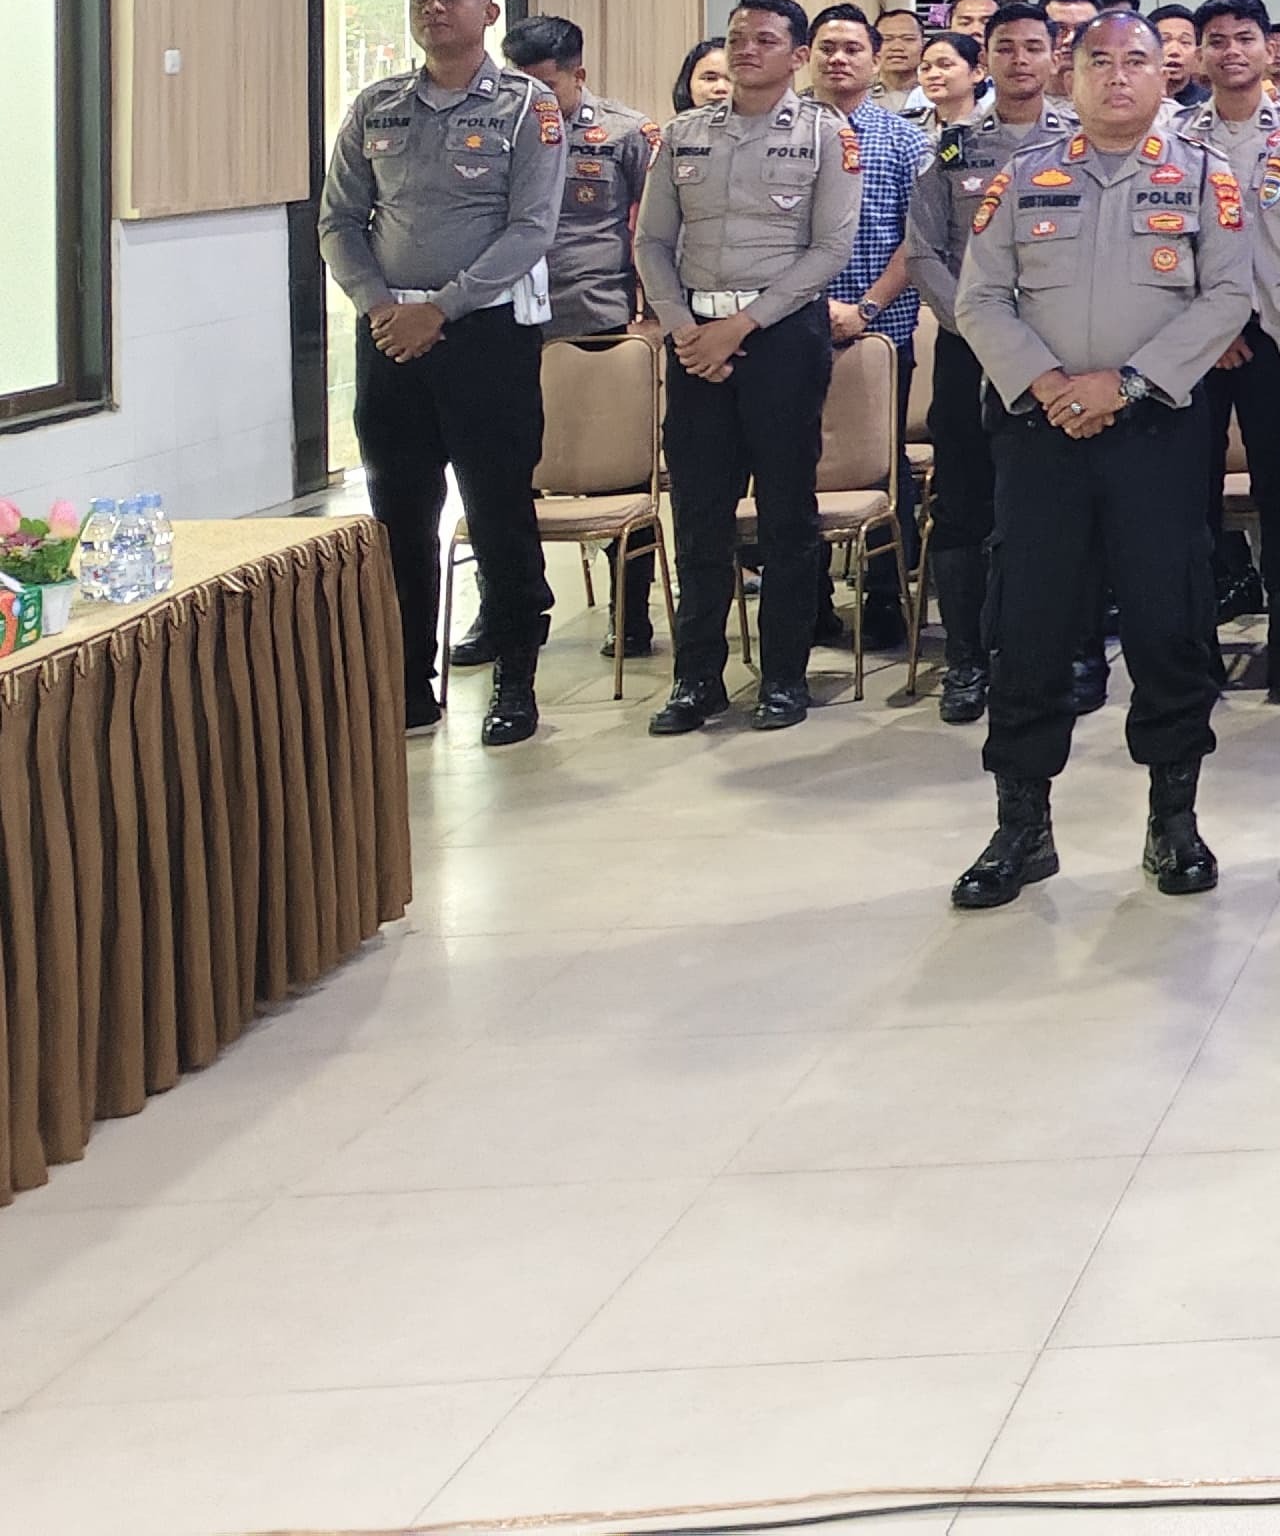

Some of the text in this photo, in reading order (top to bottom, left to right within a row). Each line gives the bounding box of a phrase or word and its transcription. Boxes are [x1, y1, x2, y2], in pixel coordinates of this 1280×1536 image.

[457, 117, 505, 129] POLRI
[766, 147, 815, 159] POLRI
[1136, 191, 1193, 206] POLRI
